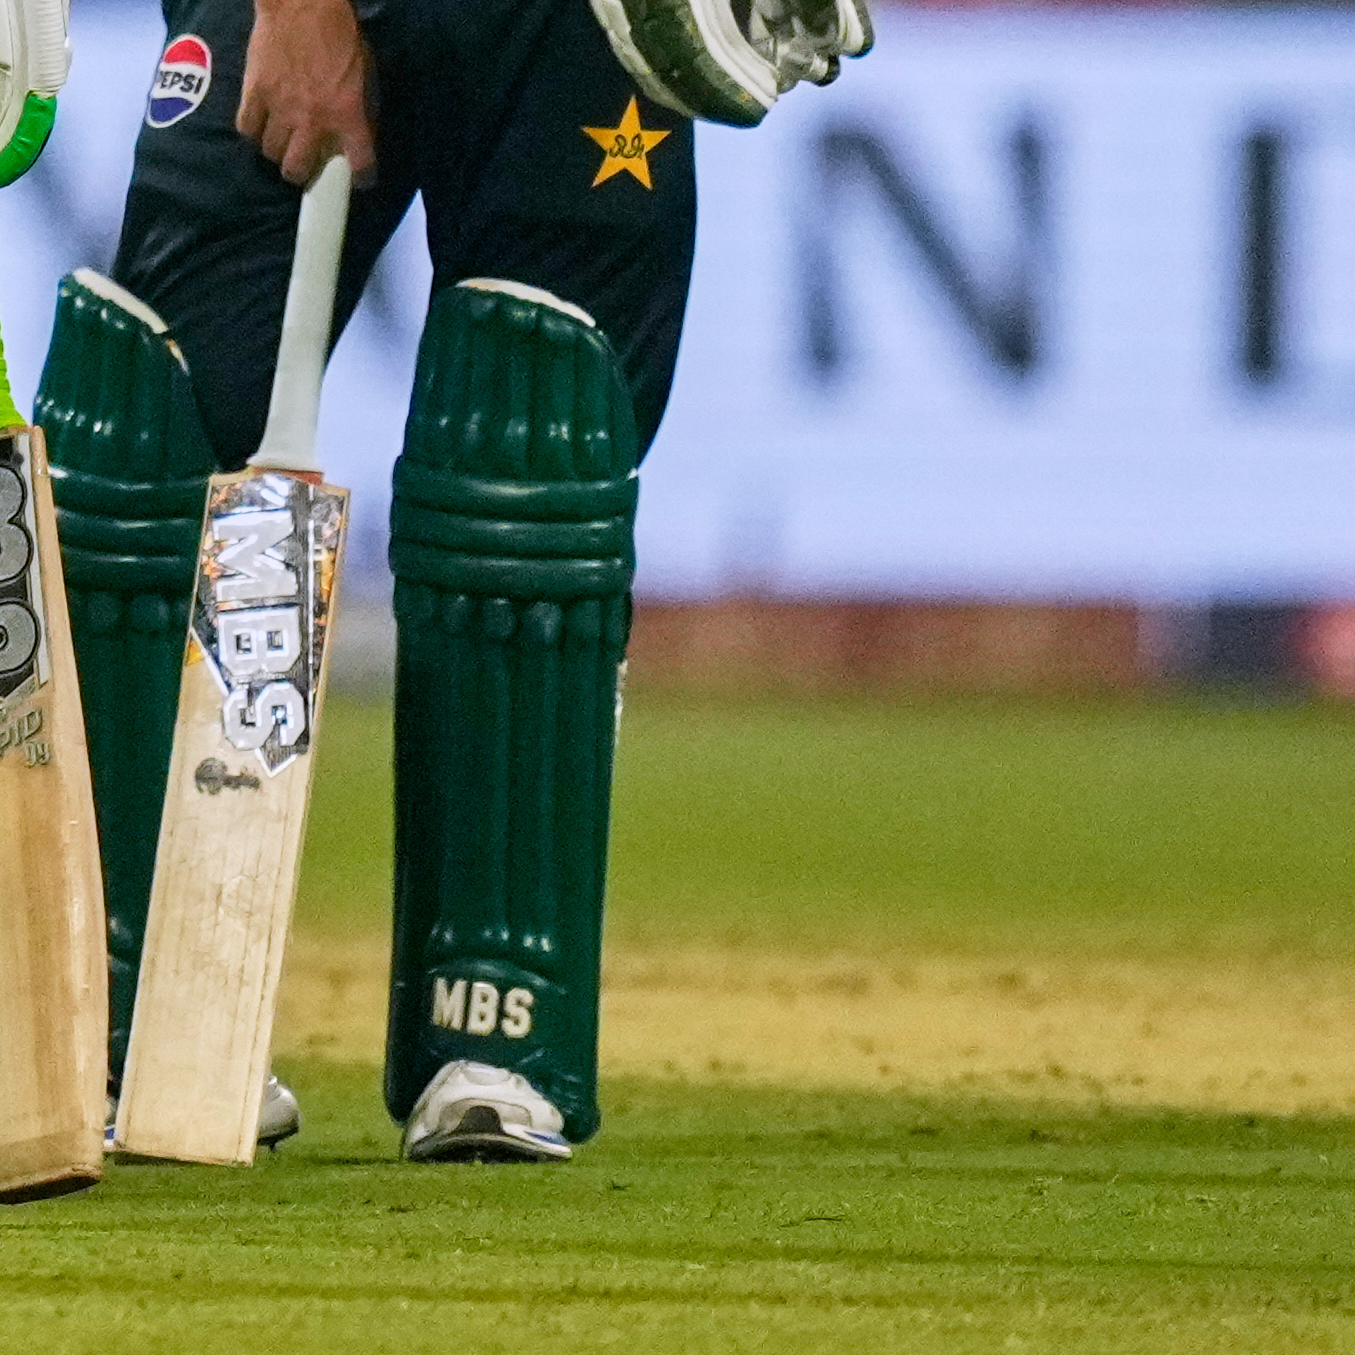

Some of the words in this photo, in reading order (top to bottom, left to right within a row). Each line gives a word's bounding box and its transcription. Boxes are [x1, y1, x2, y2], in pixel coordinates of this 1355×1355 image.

[159, 70, 205, 95] EPSI
[211, 508, 307, 751] MBS
[432, 976, 534, 1038] MBS
